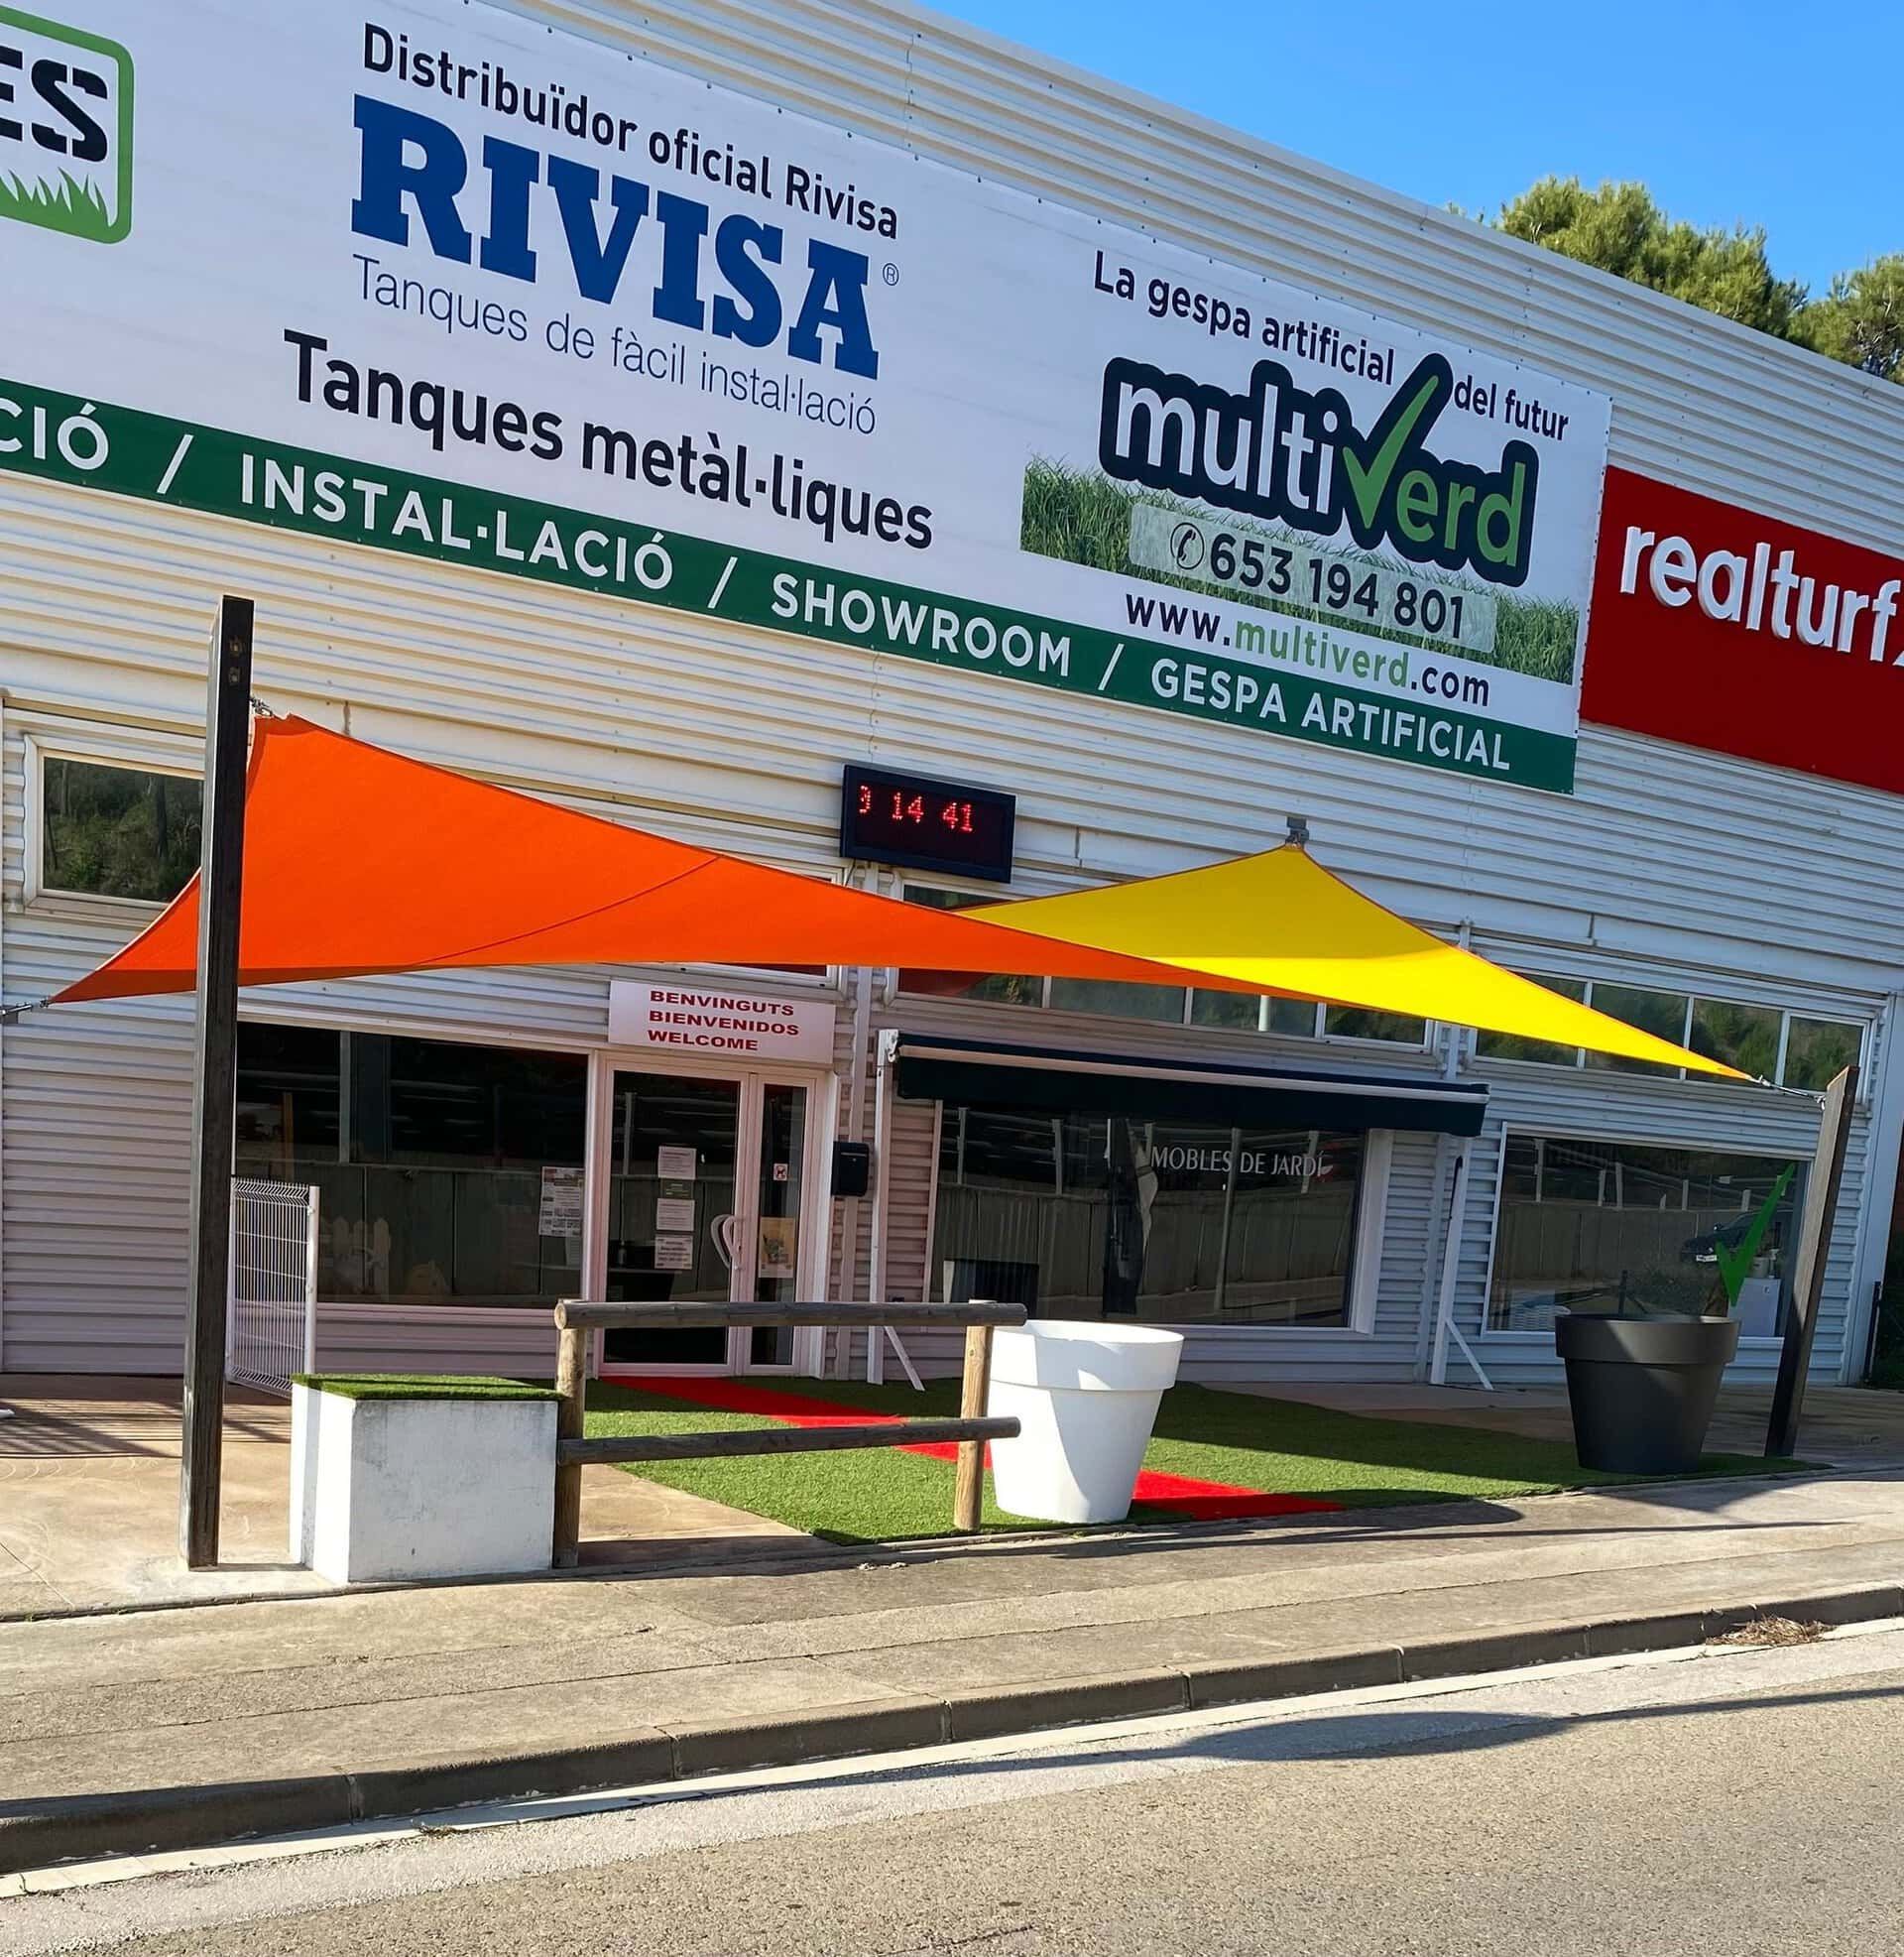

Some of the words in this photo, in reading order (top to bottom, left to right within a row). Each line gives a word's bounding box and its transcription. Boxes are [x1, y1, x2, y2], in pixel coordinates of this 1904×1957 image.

[364, 22, 639, 152] Distribuïdor
[649, 128, 773, 199] oficial
[785, 164, 897, 240] Rivisa
[352, 253, 528, 342] Tanques
[545, 311, 595, 360] de
[610, 326, 685, 386] fàcil
[1094, 249, 1135, 302] La
[1147, 278, 1250, 339] gespa
[1261, 316, 1394, 386] artificial
[1454, 374, 1497, 420] del
[1504, 388, 1570, 441] futur
[284, 328, 563, 461] Tanques
[582, 422, 932, 550] metàl·liques
[242, 453, 673, 590] INSTAL·LACIÓ
[771, 572, 1071, 676] SHOWROOM
[1151, 658, 1287, 723] GESPA
[1300, 692, 1511, 771] ARTIFICIAL
[1211, 533, 1293, 595] 653
[1309, 558, 1379, 620] 194
[1393, 581, 1464, 640] 801
[1126, 593, 1489, 707] www.multiverd.com
[892, 792, 924, 823] 14
[942, 801, 973, 832] 41
[648, 1030, 759, 1051] WELCOME
[649, 1010, 800, 1036] BIENVENIDOS
[650, 990, 795, 1017] BENVINGUTS
[1150, 1146, 1234, 1172] MOBLES
[1239, 1152, 1267, 1174] DE
